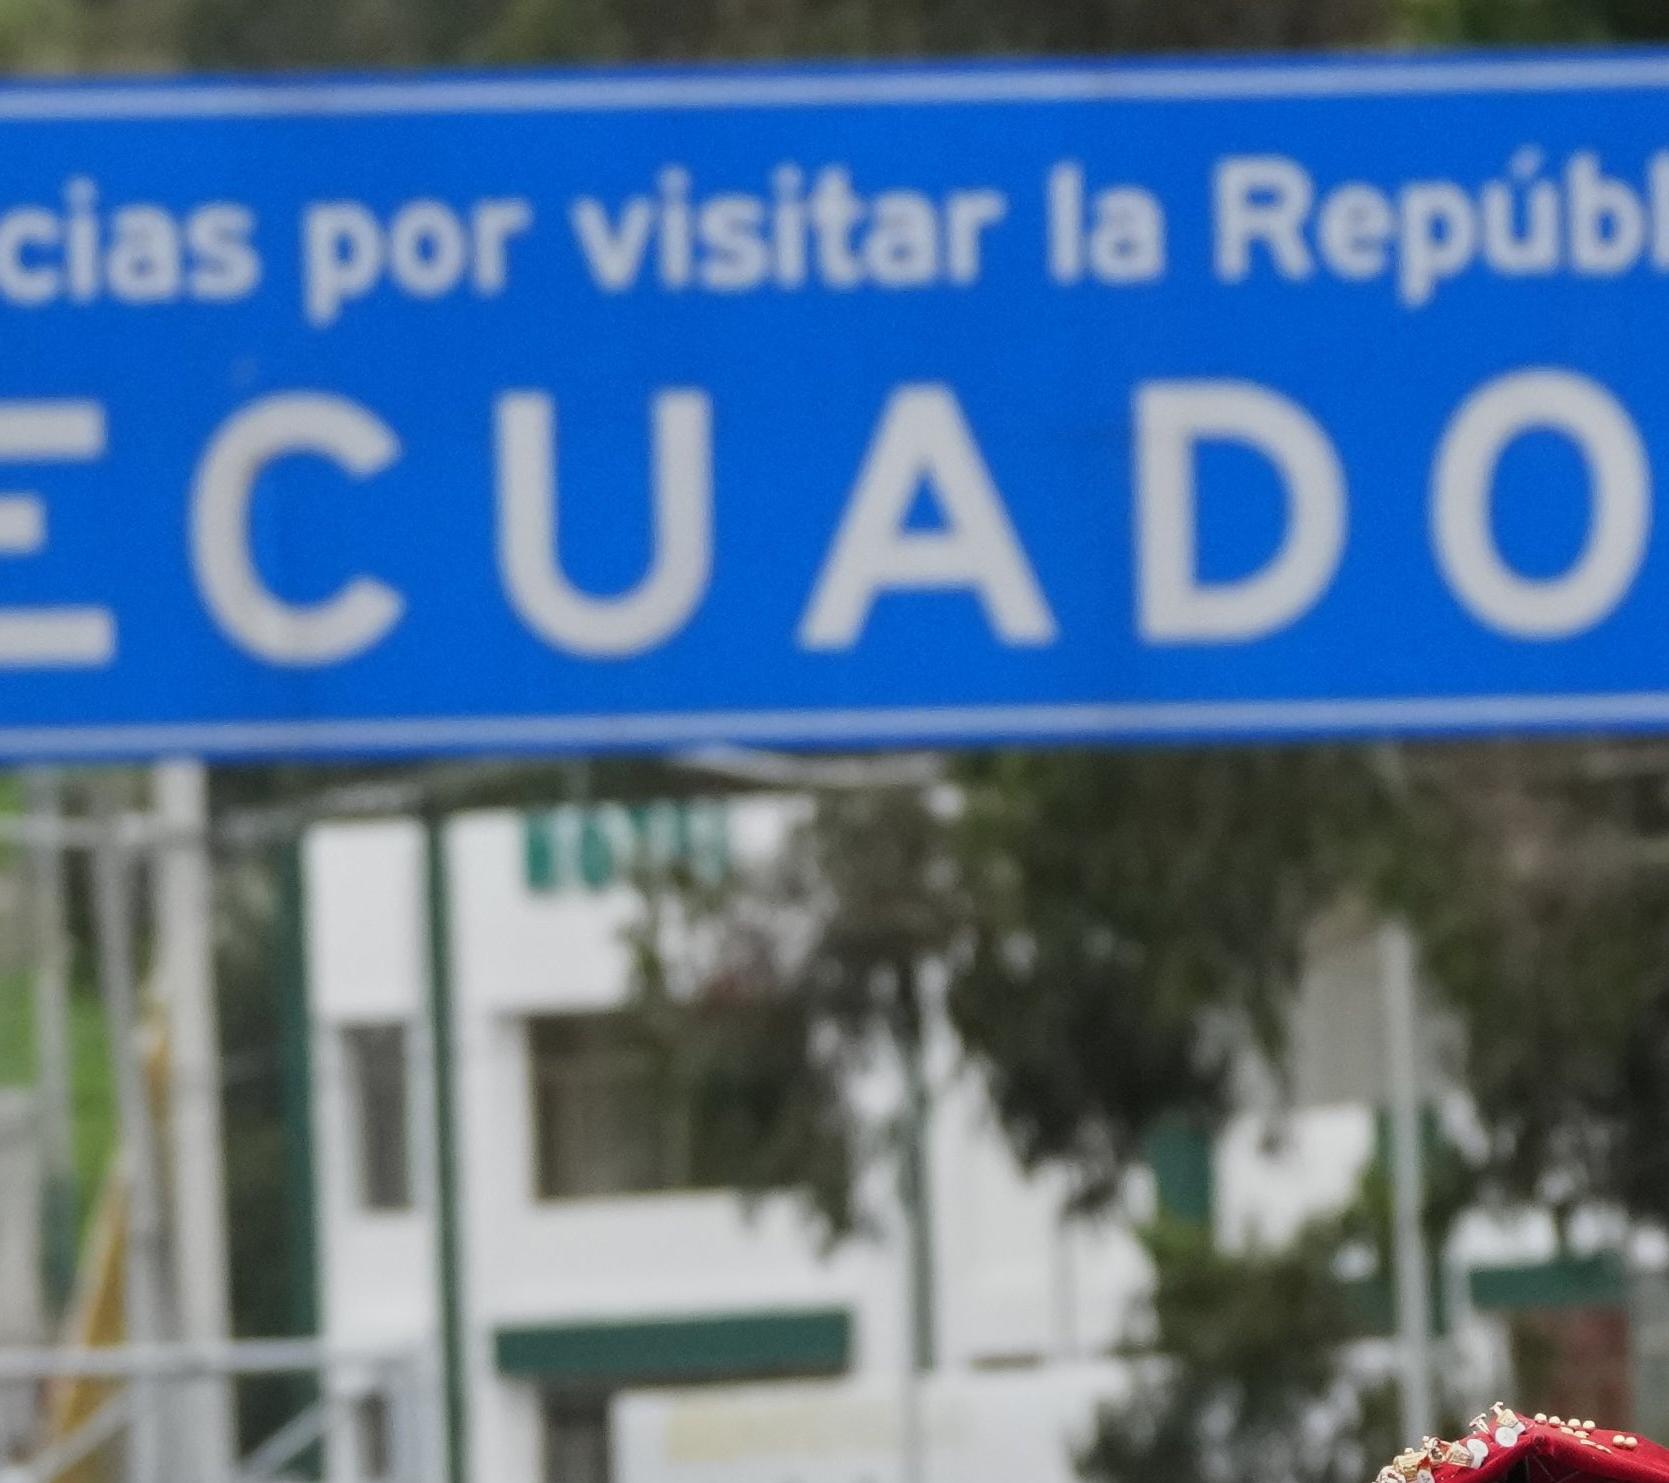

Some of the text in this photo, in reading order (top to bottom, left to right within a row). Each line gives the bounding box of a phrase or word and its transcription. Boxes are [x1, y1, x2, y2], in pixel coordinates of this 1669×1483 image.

[307, 203, 524, 317] por
[577, 171, 1000, 286] visitar
[1052, 168, 1162, 280] la
